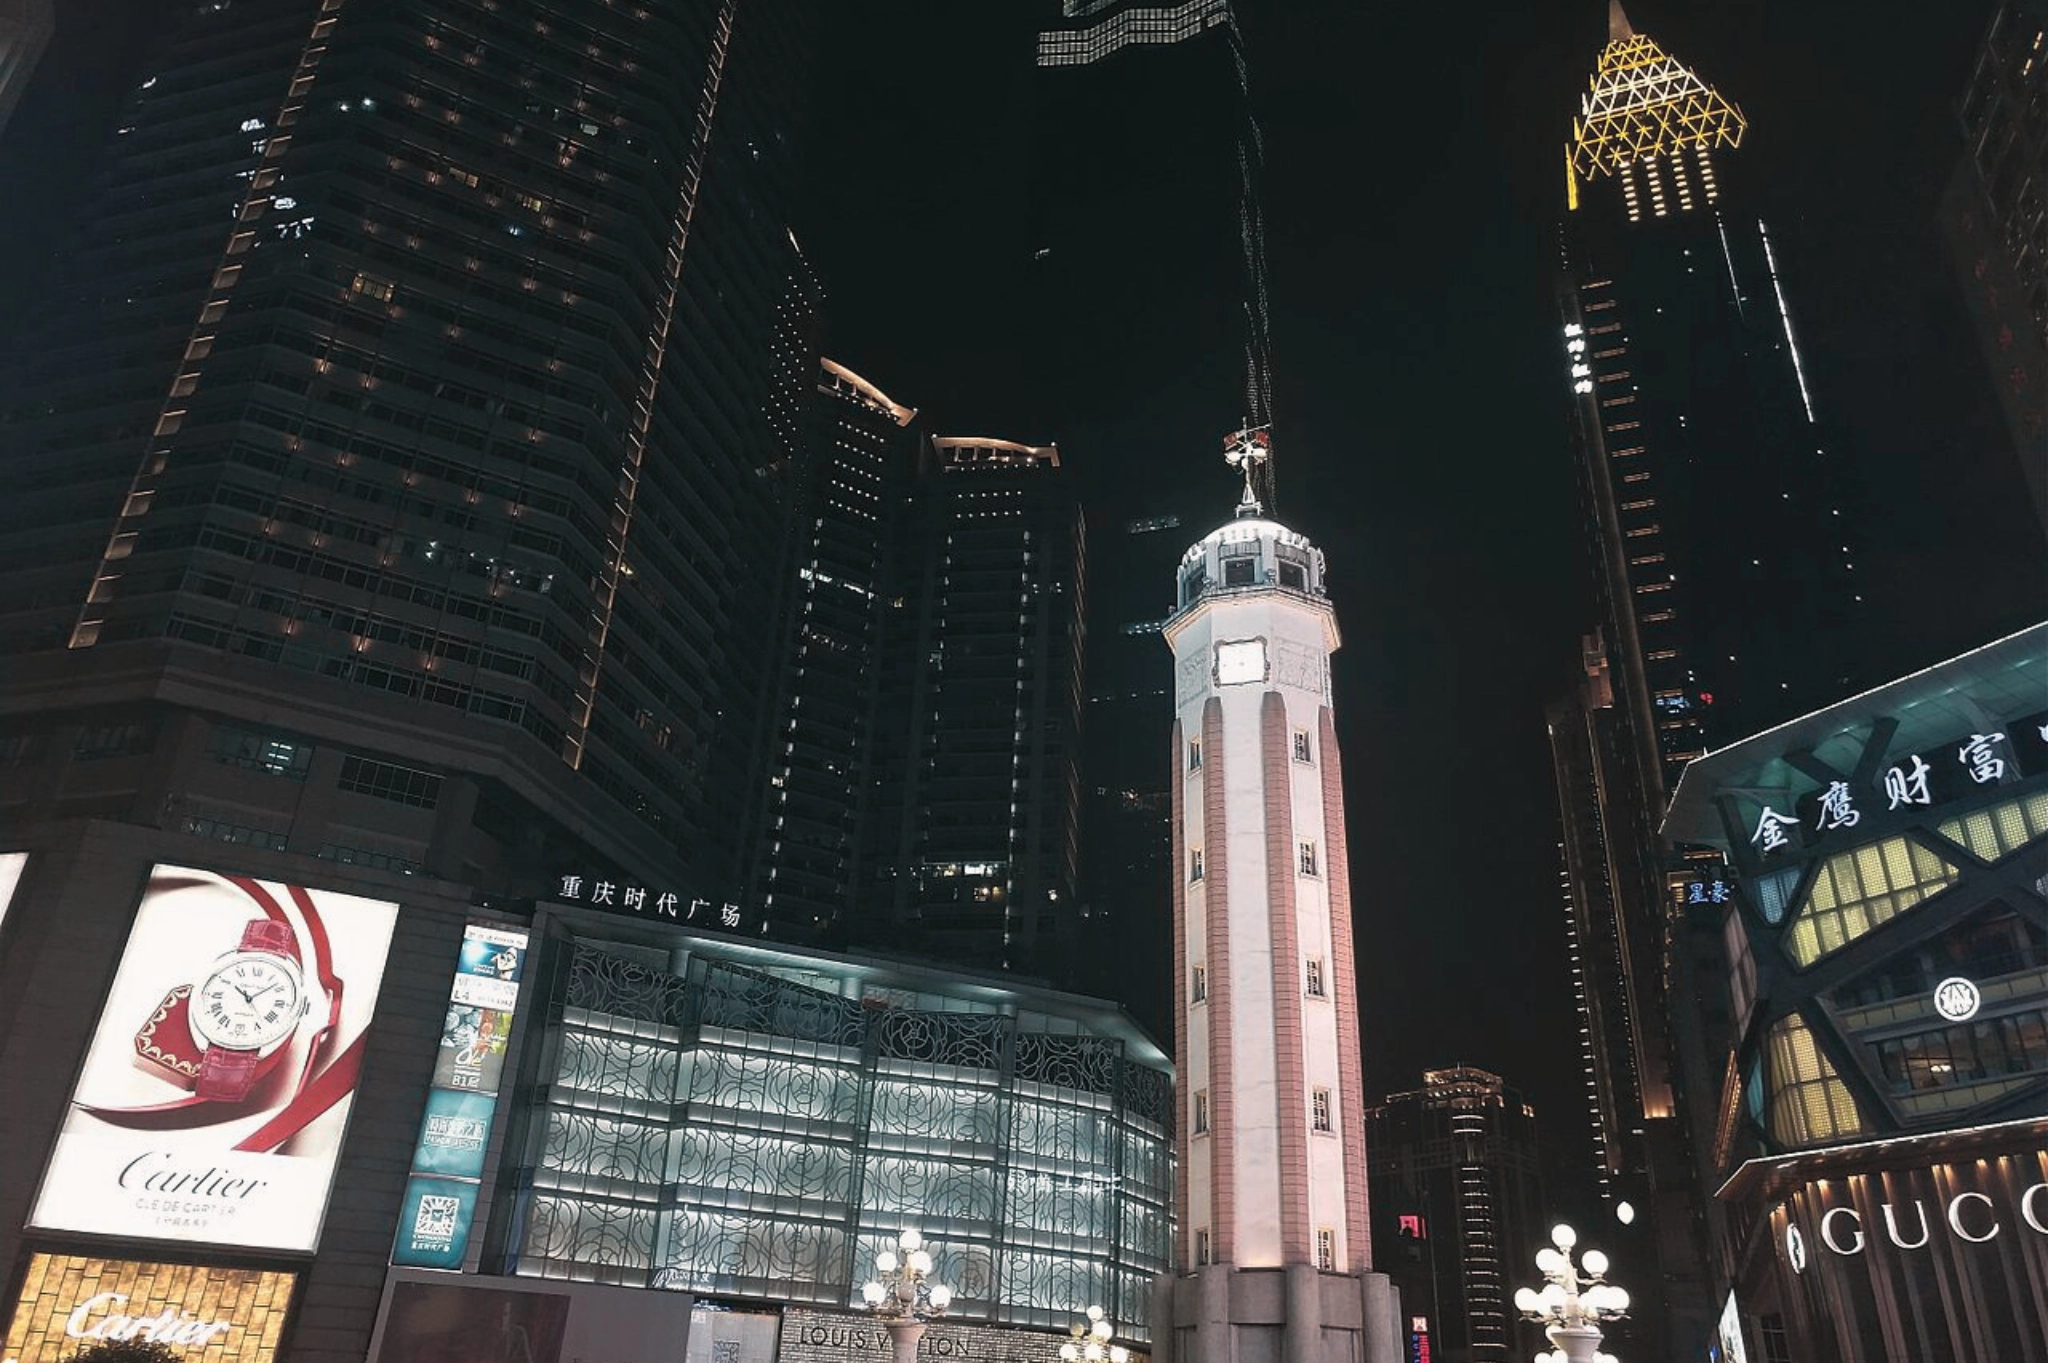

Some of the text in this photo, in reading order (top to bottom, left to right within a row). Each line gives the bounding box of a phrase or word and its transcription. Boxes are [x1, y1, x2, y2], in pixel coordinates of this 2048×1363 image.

[1751, 724, 2048, 851] 金鹰财富
[558, 874, 741, 927] 重庆时代广场
[118, 1151, 268, 1198] Cartier
[66, 1292, 231, 1346] Cartier
[800, 1326, 970, 1355] LOUIS VTTON
